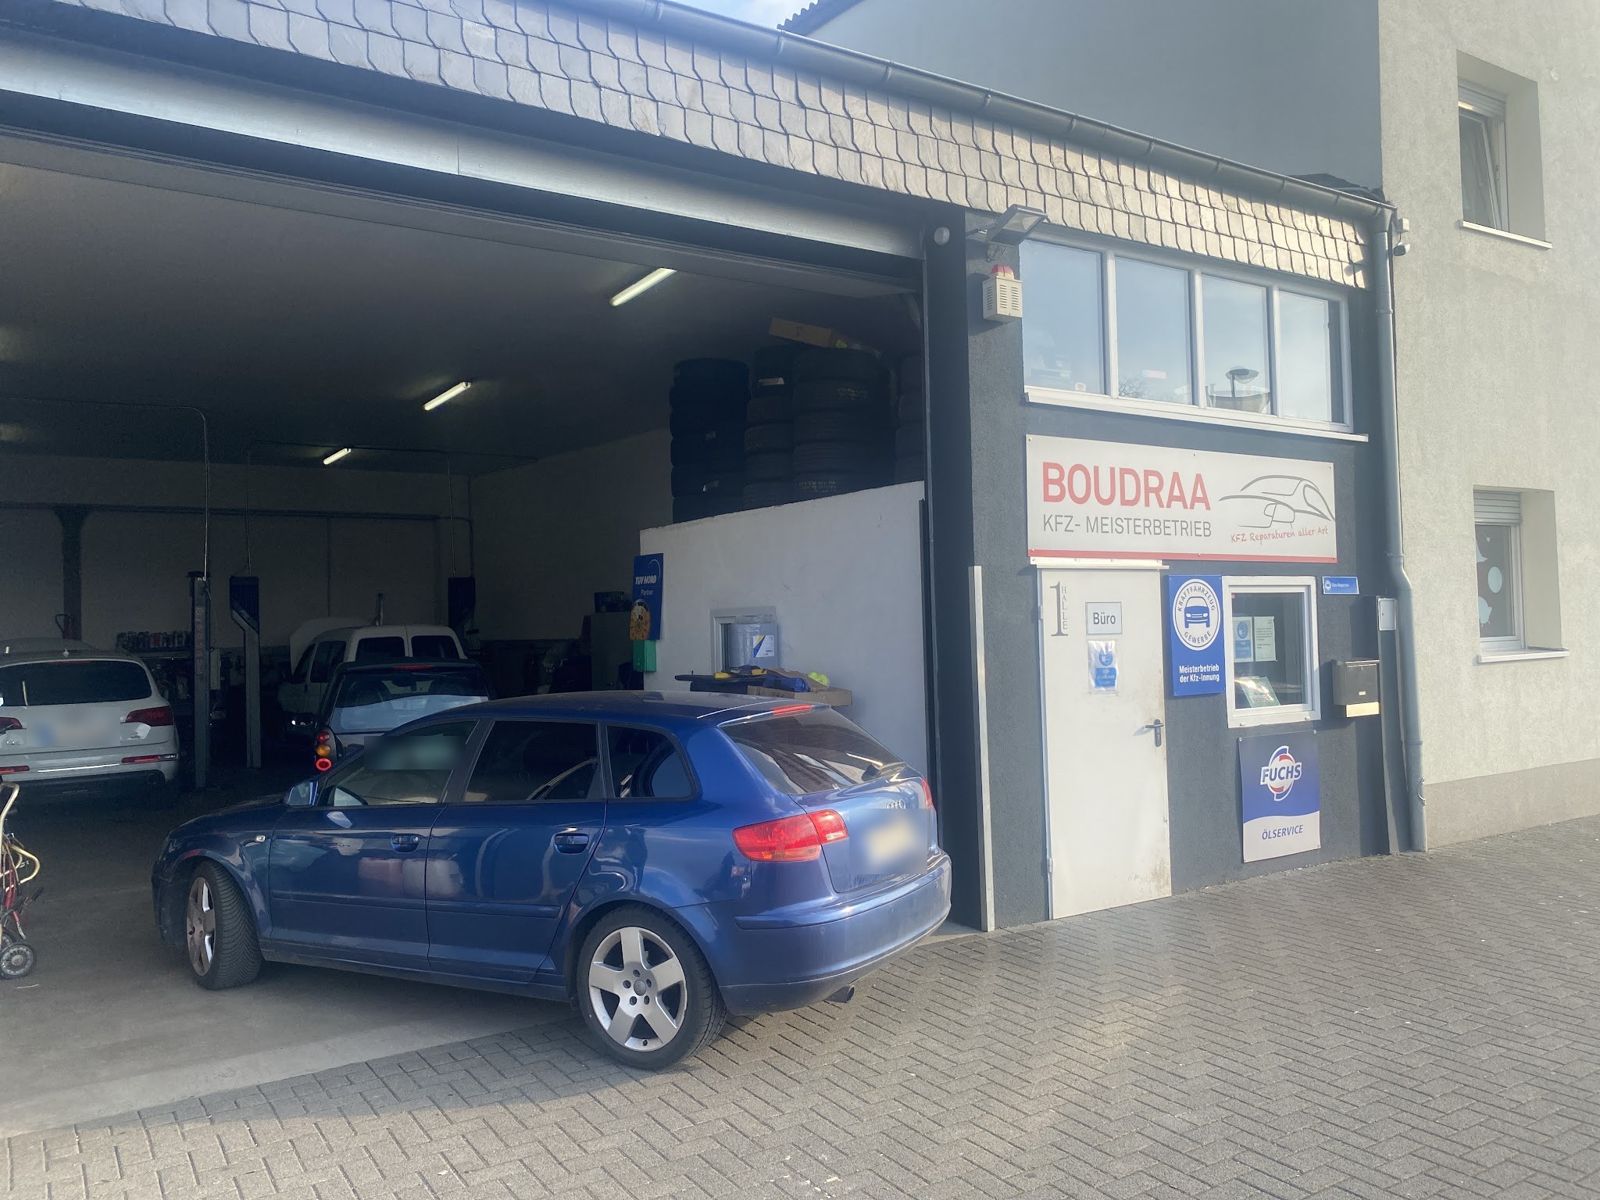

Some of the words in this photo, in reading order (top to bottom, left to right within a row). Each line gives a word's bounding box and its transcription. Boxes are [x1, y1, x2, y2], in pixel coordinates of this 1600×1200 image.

[1042, 461, 1211, 511] BOUDRAA
[1043, 514, 1081, 533] KFZ-
[1086, 515, 1212, 538] MEISTERBETRIEB
[1231, 532, 1247, 543] KFZ
[1249, 529, 1296, 545] Reparaturen
[1297, 527, 1315, 537] aller
[1317, 525, 1329, 535] Art
[1177, 585, 1216, 612] KRAFTFAHRZEUG
[1049, 581, 1069, 637] 1
[1093, 612, 1116, 625] Büro
[1184, 630, 1212, 644] GEWERBE
[1179, 663, 1220, 674] Meisterbetrieb
[1179, 674, 1189, 683] der
[1189, 673, 1220, 682] Kfz-Innung
[1262, 764, 1301, 783] FUCHS
[1262, 824, 1304, 841] ÖLSERVICE
